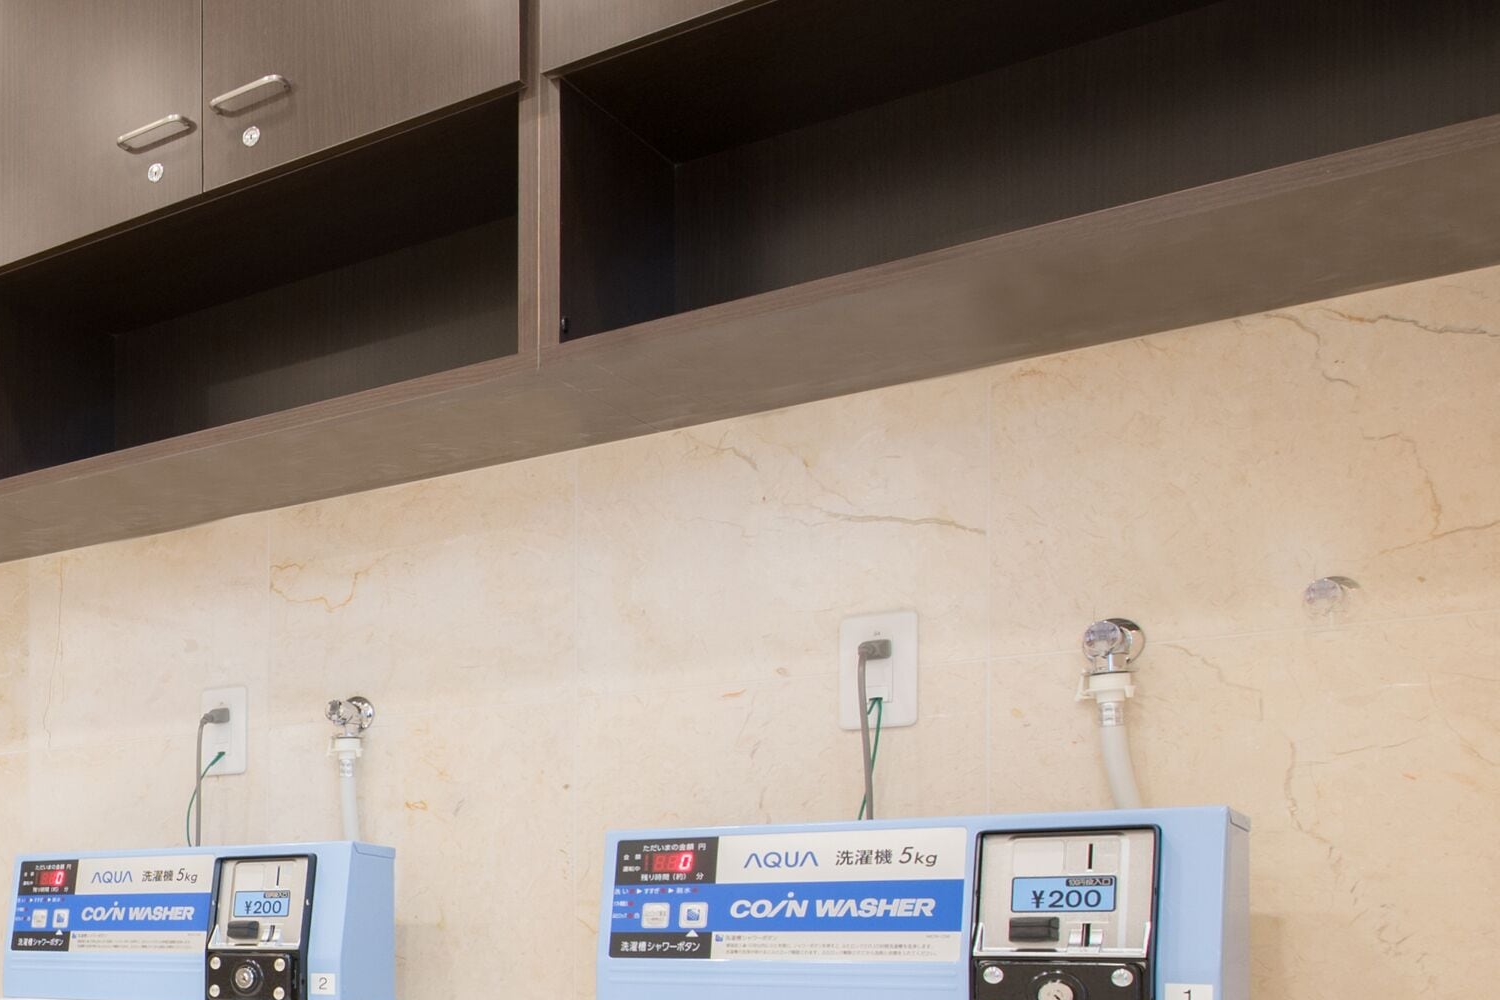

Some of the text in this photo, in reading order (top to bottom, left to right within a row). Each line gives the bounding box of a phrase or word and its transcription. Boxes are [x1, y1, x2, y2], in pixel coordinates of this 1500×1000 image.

[744, 851, 819, 869] AQUA
[835, 846, 938, 867] 洗濯機 5kg
[55, 872, 64, 885] 0
[91, 871, 133, 884] AQUA
[141, 868, 198, 884] 洗濯機 5kg
[1031, 889, 1102, 909] ¥200
[128, 905, 195, 921] WASHER
[244, 900, 282, 915] ¥200
[815, 897, 936, 918] WASHER
[318, 977, 328, 991] 2
